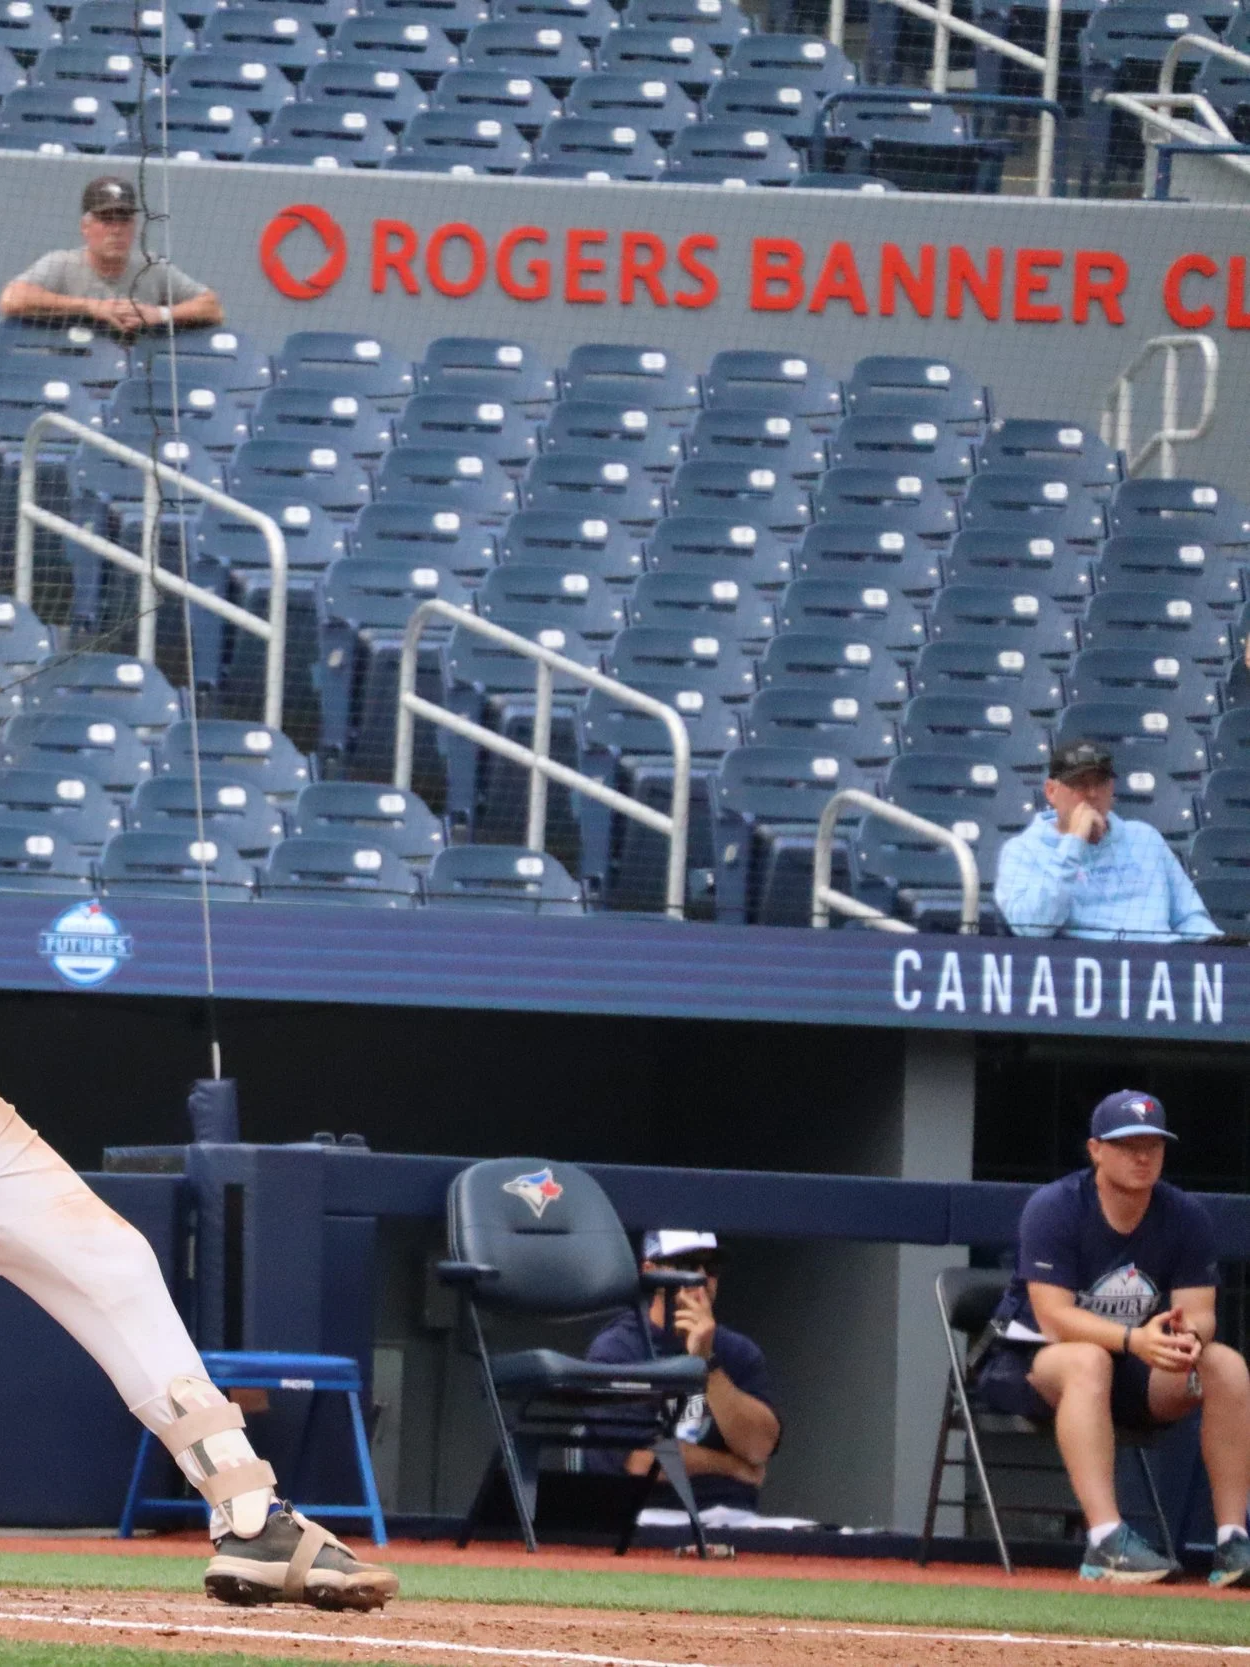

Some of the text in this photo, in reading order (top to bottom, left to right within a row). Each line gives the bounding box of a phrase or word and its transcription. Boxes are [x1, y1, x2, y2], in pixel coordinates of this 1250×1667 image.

[371, 218, 720, 309] ROGERS
[750, 237, 1126, 325] BANNER
[45, 936, 127, 954] FUTURES
[893, 948, 1224, 1024] CANADIAN
